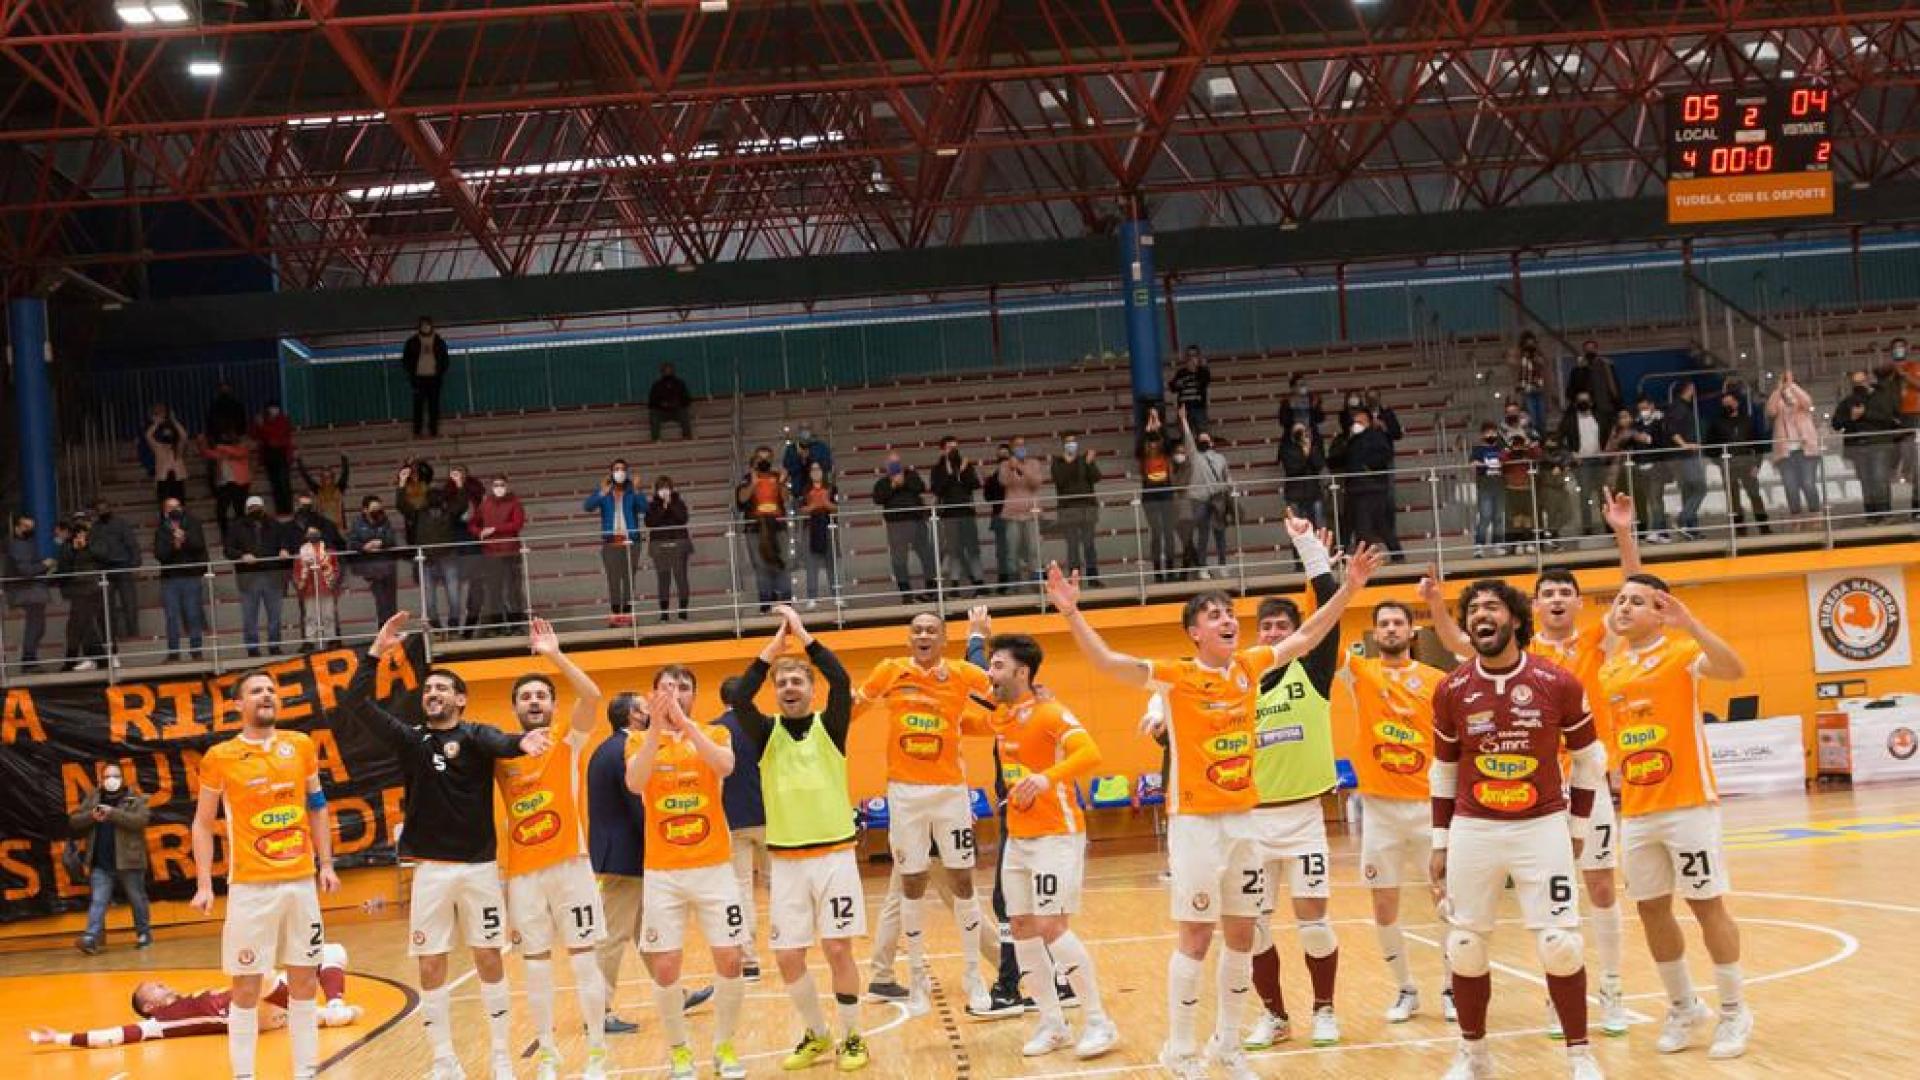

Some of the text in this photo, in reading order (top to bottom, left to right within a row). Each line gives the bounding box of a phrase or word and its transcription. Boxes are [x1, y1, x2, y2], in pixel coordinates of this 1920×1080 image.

[1684, 95, 1719, 121] 05
[1791, 89, 1828, 115] 04
[1744, 107, 1758, 127] 2
[1675, 127, 1719, 142] LOCAL
[1683, 150, 1696, 168] 4
[1817, 142, 1831, 161] 2
[1285, 682, 1305, 699] 13
[432, 754, 447, 771] 5
[951, 829, 974, 850] 18
[1595, 824, 1611, 848] 7
[1299, 853, 1325, 876] 13
[1679, 850, 1710, 877] 21
[1034, 873, 1057, 895] 10
[1550, 876, 1571, 902] 6
[483, 907, 500, 929] 5
[571, 905, 595, 927] 11
[726, 905, 742, 926] 8
[829, 897, 854, 918] 12
[310, 922, 321, 945] 2
